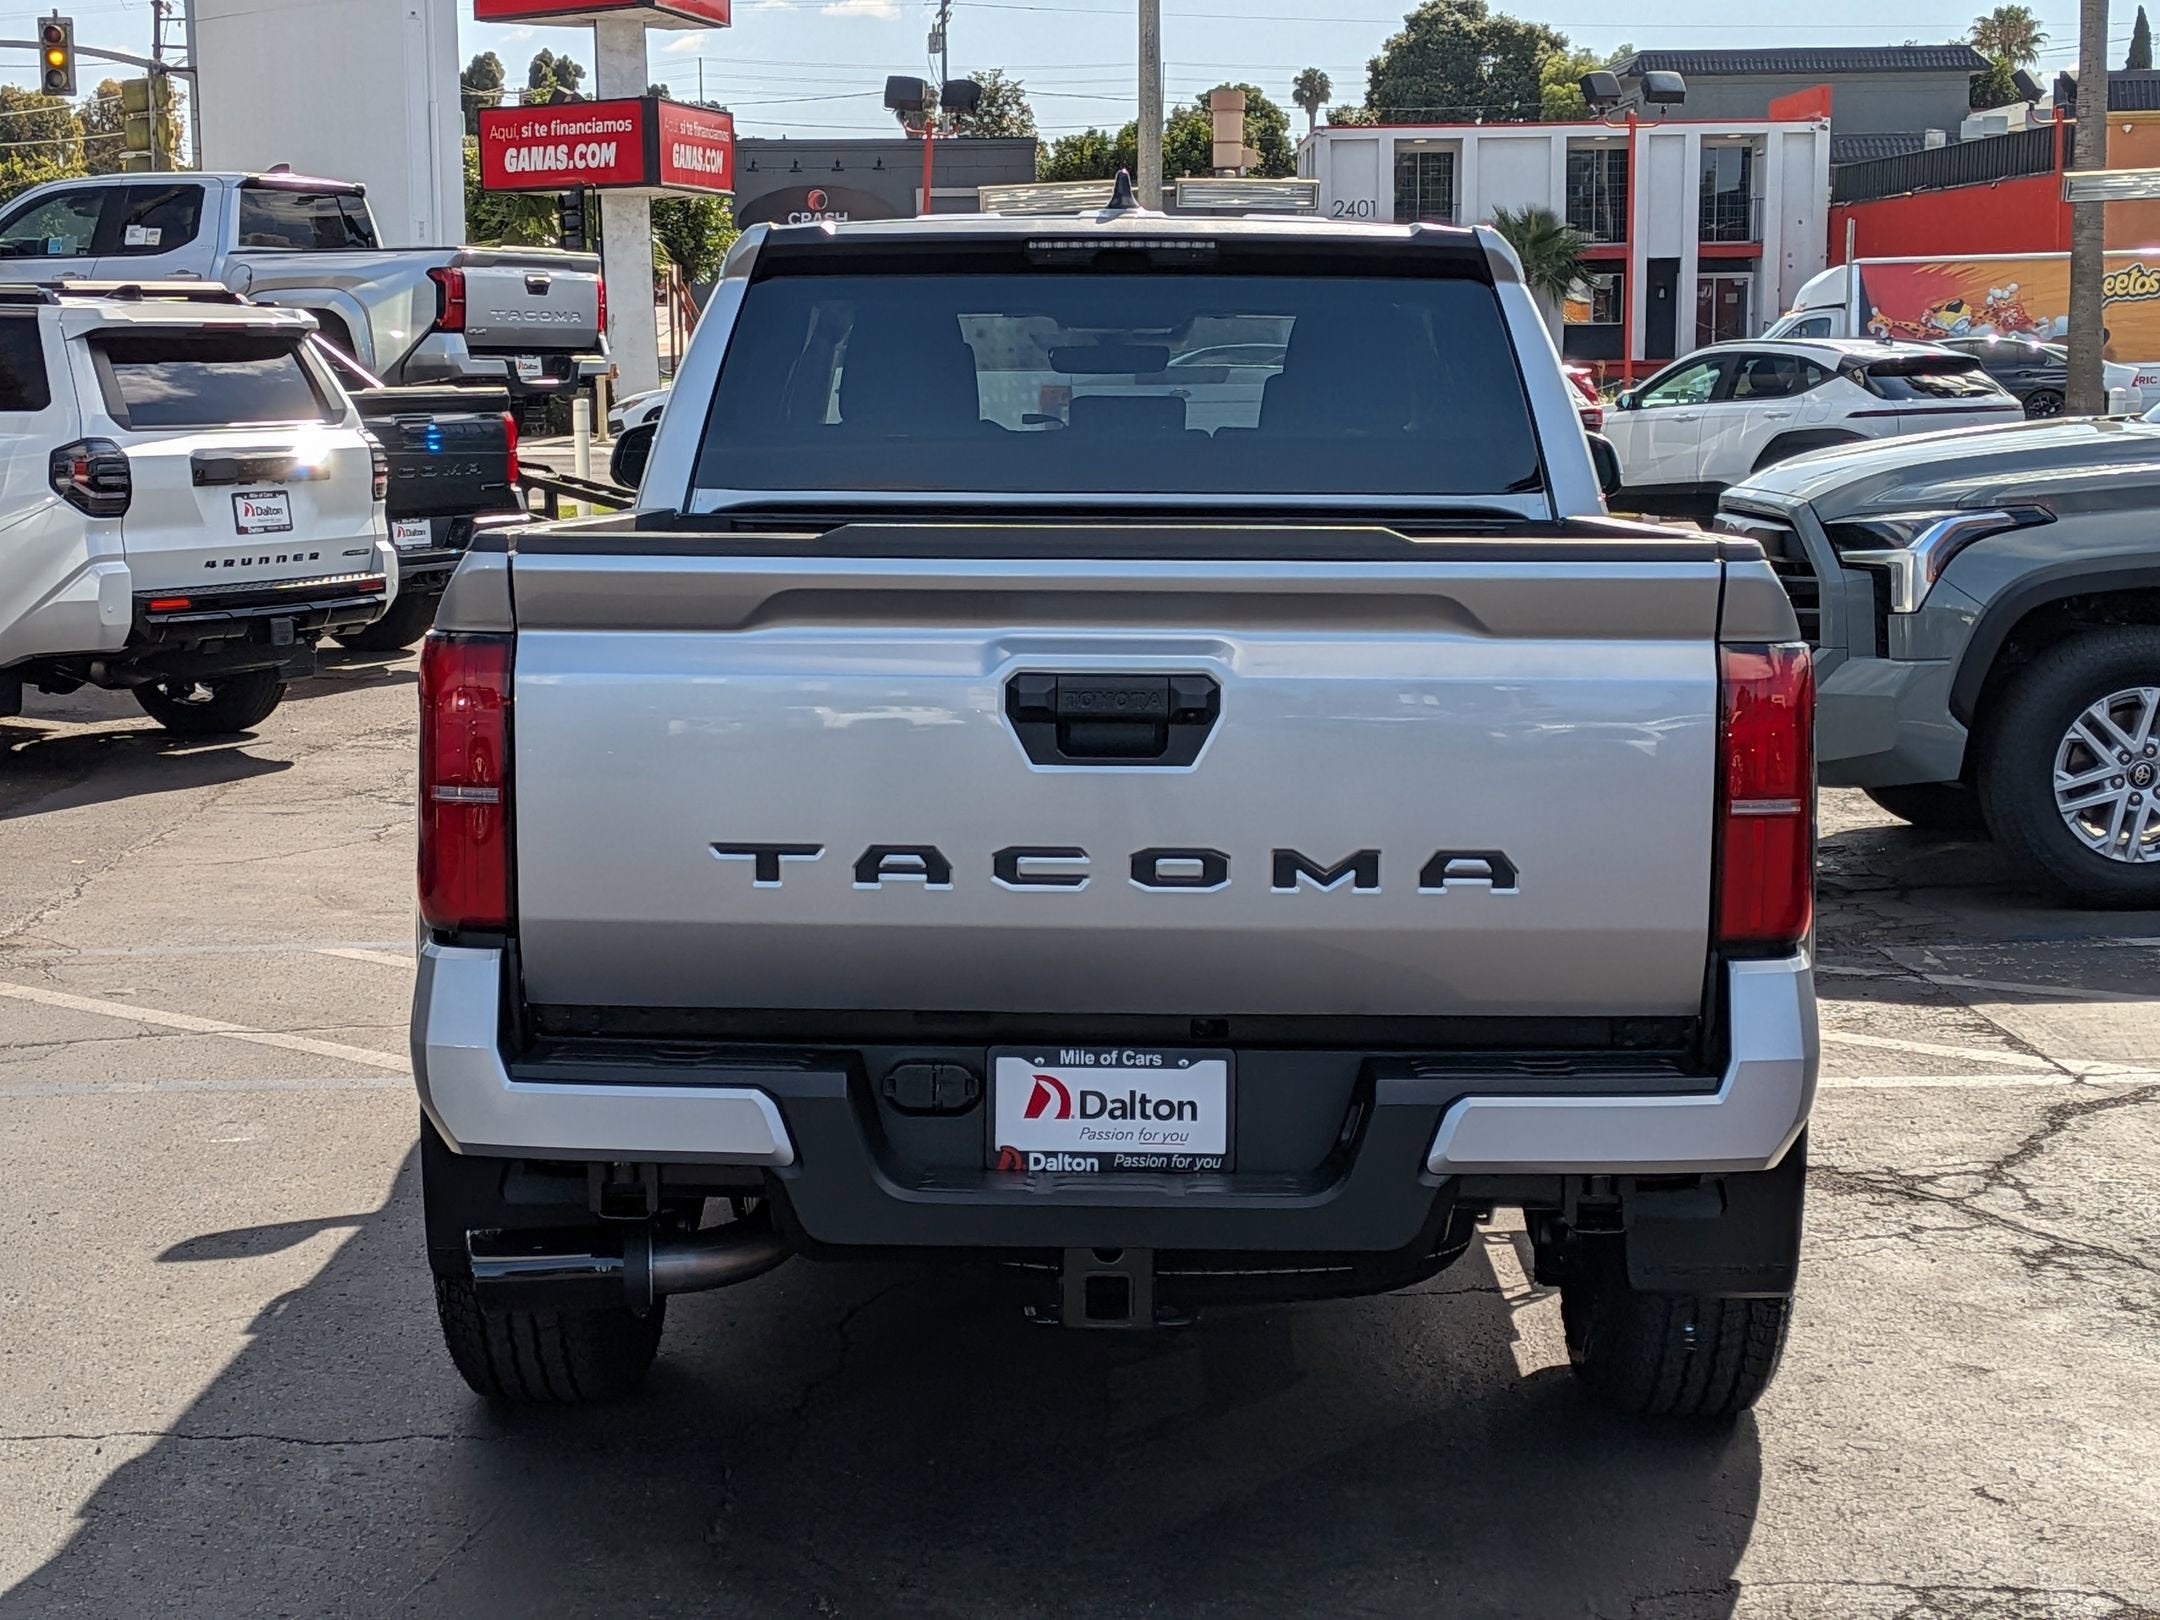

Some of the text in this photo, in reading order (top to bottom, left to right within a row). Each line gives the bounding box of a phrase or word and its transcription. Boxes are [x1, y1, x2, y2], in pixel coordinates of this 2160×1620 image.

[489, 123, 519, 142] Aquí,
[534, 122, 548, 137] te
[551, 116, 633, 136] financiamos
[504, 141, 617, 173] GANAS.COM
[672, 142, 724, 175] GANAS.COM
[787, 211, 849, 225] CRASH
[1332, 199, 1376, 218] 2401
[490, 309, 581, 323] TACOMA
[256, 505, 283, 517] Dalton
[1063, 690, 1165, 710] TOYOTA
[708, 842, 1521, 895] TACOMA
[1060, 1049, 1163, 1067] Mile of Cars
[1079, 1089, 1198, 1122] Dalton
[1079, 1127, 1189, 1144] Passion for you
[1028, 1152, 1099, 1172] Dalton
[1114, 1153, 1222, 1170] Passion for you
